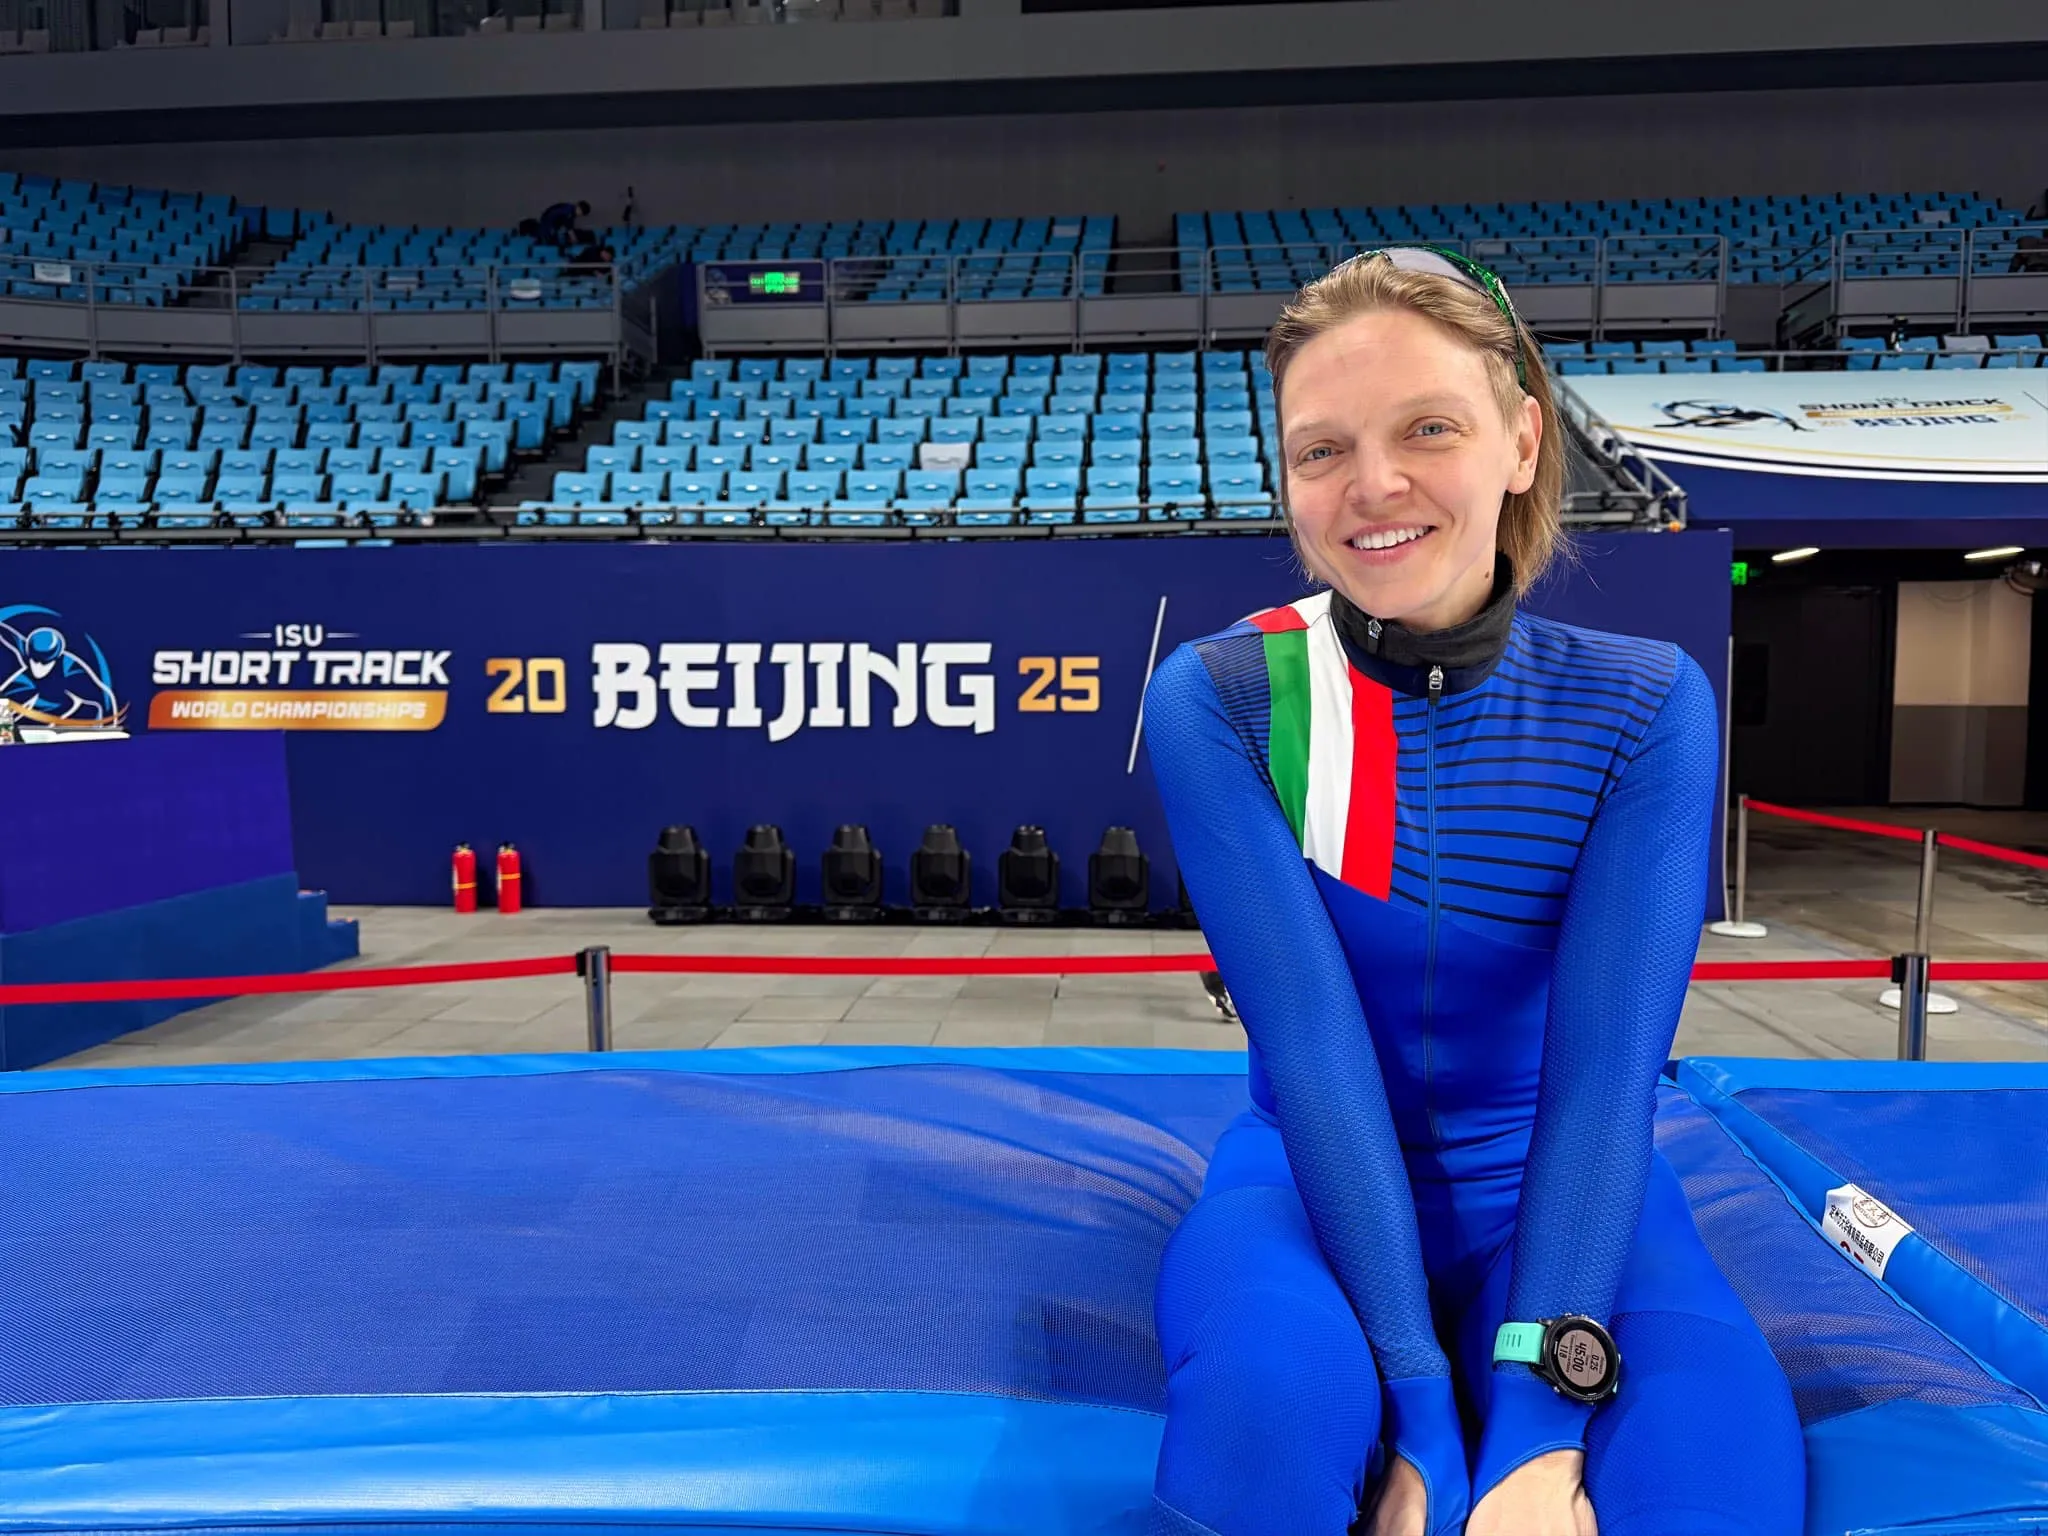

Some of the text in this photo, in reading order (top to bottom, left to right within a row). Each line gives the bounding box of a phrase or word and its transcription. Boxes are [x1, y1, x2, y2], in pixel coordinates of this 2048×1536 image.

[1850, 415, 1998, 426] BEIJING
[275, 625, 323, 647] ISU
[152, 651, 452, 685] SHORT TRACK
[486, 643, 1100, 742] 20 BEIJING 25
[171, 701, 427, 719] WORLD CHAMPIONSHIPS
[1573, 1342, 1587, 1373] 45:00
[1590, 1354, 1599, 1371] 0.25
